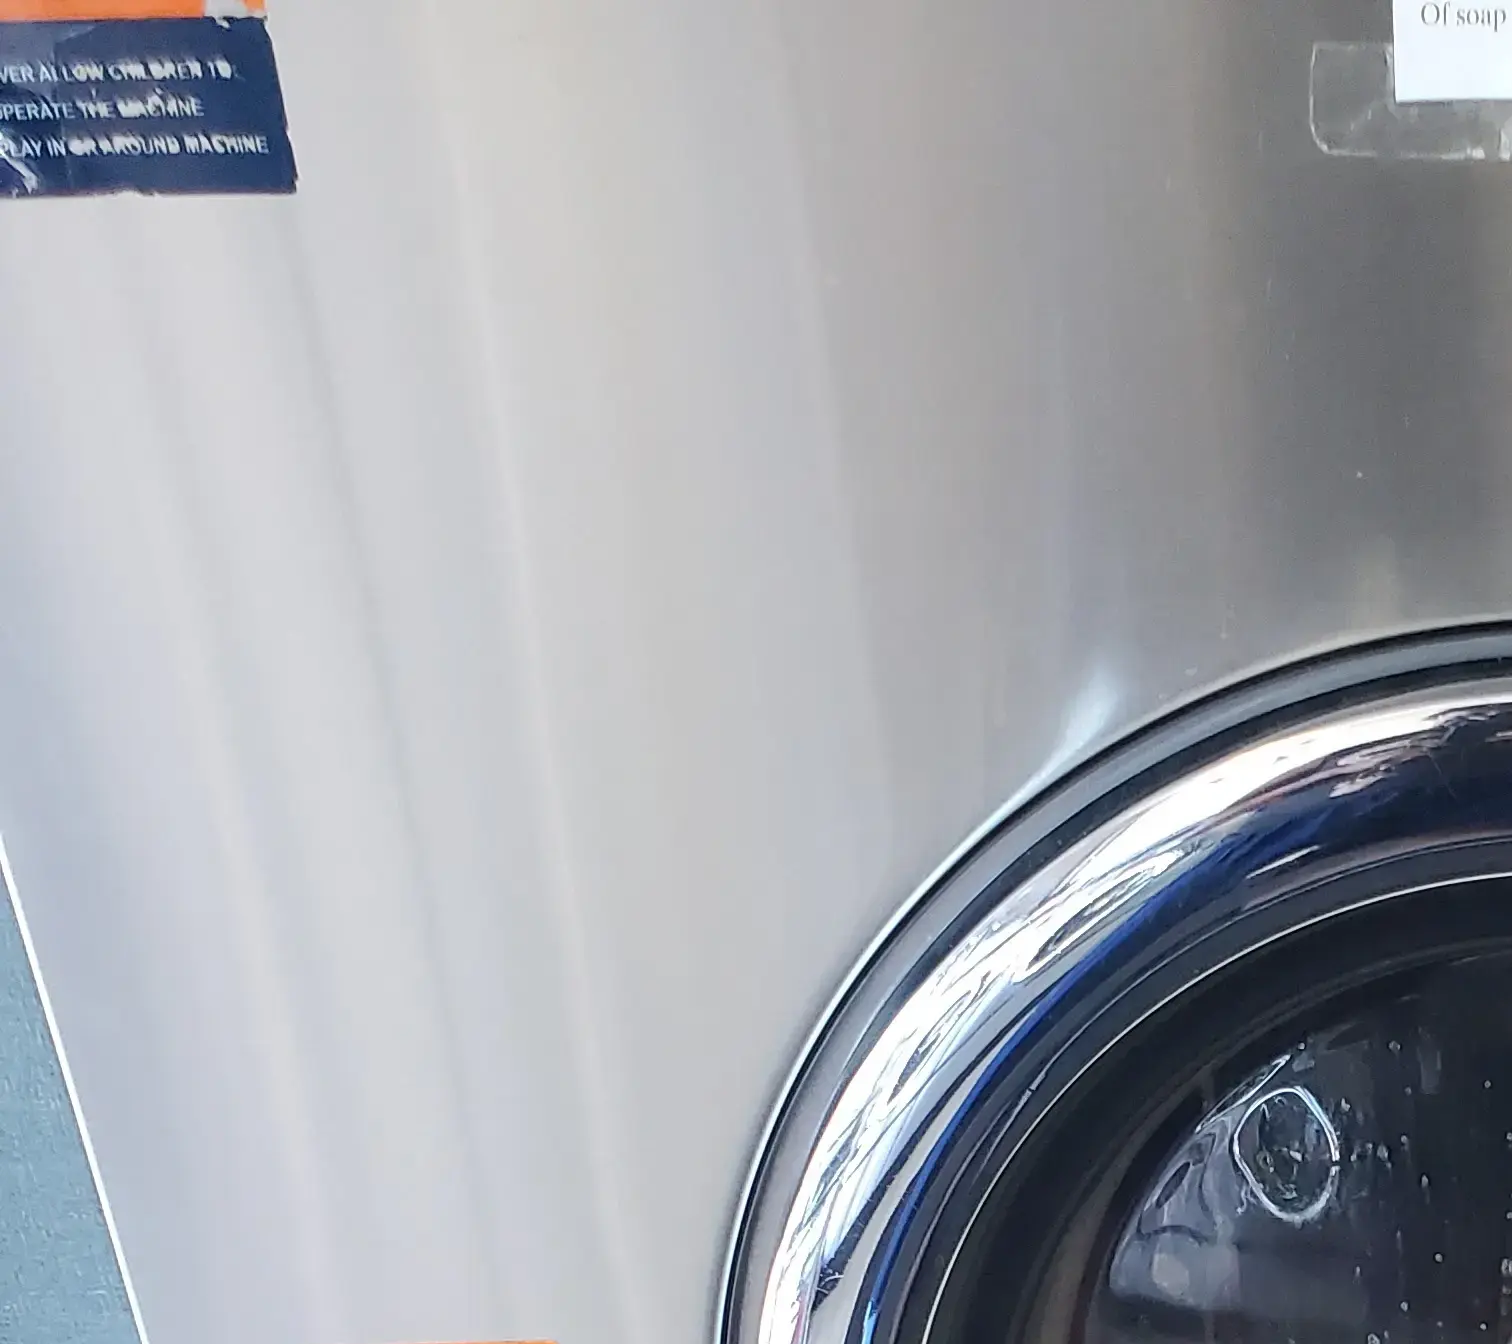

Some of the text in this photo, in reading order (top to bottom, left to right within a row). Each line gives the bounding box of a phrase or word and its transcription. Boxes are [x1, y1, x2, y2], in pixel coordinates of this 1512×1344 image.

[1420, 1, 1451, 26] Of
[1456, 7, 1507, 33] soap
[75, 98, 116, 119] THE
[46, 136, 66, 157] IN
[183, 133, 269, 154] MACHINE
